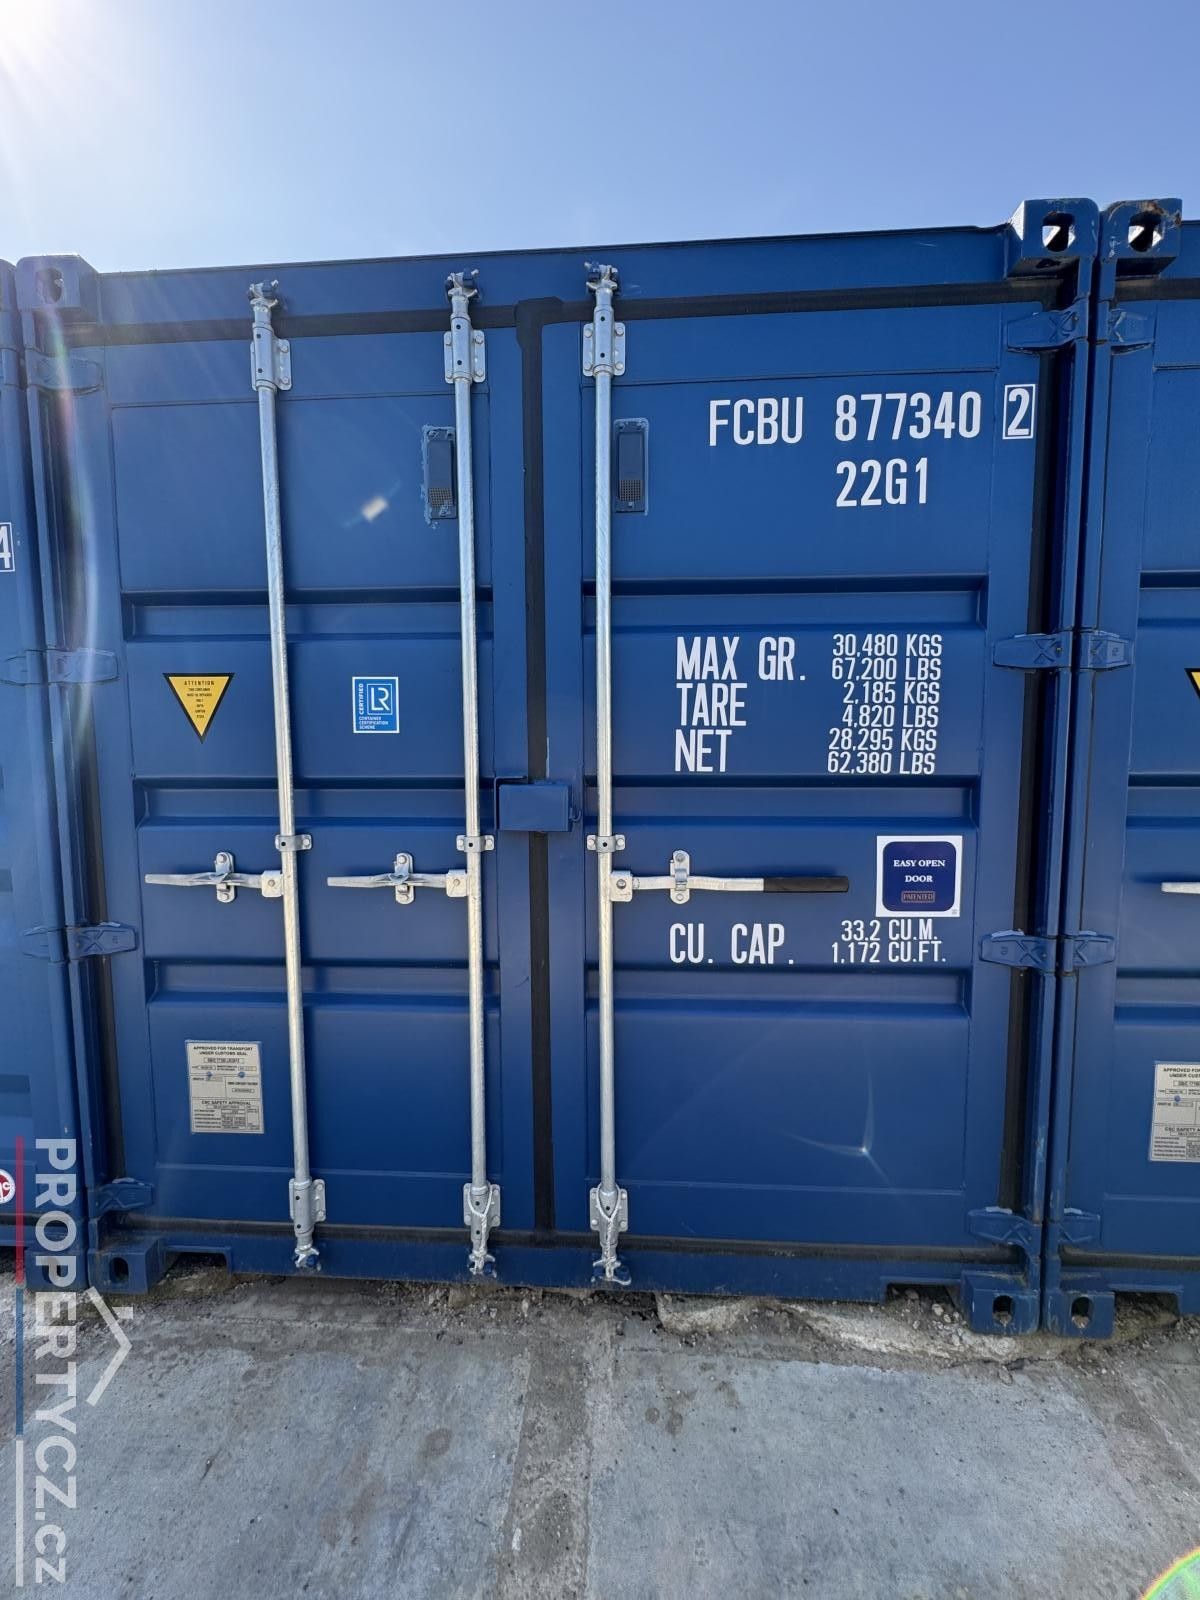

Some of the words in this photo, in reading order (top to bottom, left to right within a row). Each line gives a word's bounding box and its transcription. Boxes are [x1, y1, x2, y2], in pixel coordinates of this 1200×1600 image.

[709, 397, 803, 447] FCBU
[834, 391, 982, 442] 877340
[1006, 387, 1031, 436] 2
[835, 457, 928, 507] 22G1
[676, 636, 740, 681] MAX
[757, 636, 806, 681] GR.
[832, 633, 899, 658] 30,480
[905, 633, 943, 657] KGS
[831, 657, 898, 681] 67,200
[904, 657, 942, 681] LBS
[675, 682, 748, 727] TARE
[842, 681, 897, 704] 2,185
[903, 680, 941, 704] KGS
[841, 704, 896, 728] 4,820
[902, 704, 939, 728] LBS
[674, 729, 733, 773] NET
[828, 727, 894, 751] 28,295
[900, 728, 938, 751] KGS
[827, 751, 893, 774] 62,380
[899, 752, 936, 775] LBS
[893, 859, 917, 868] EASY
[918, 859, 946, 868] OPEN
[904, 874, 934, 883] DOOR
[902, 892, 934, 901] PATENTED
[669, 922, 714, 964] CU.
[731, 922, 794, 965] CAP.
[840, 919, 881, 941] 33.2
[888, 918, 938, 941] CU.M.
[831, 942, 881, 964] 1,172
[888, 941, 947, 963] CU.FT.
